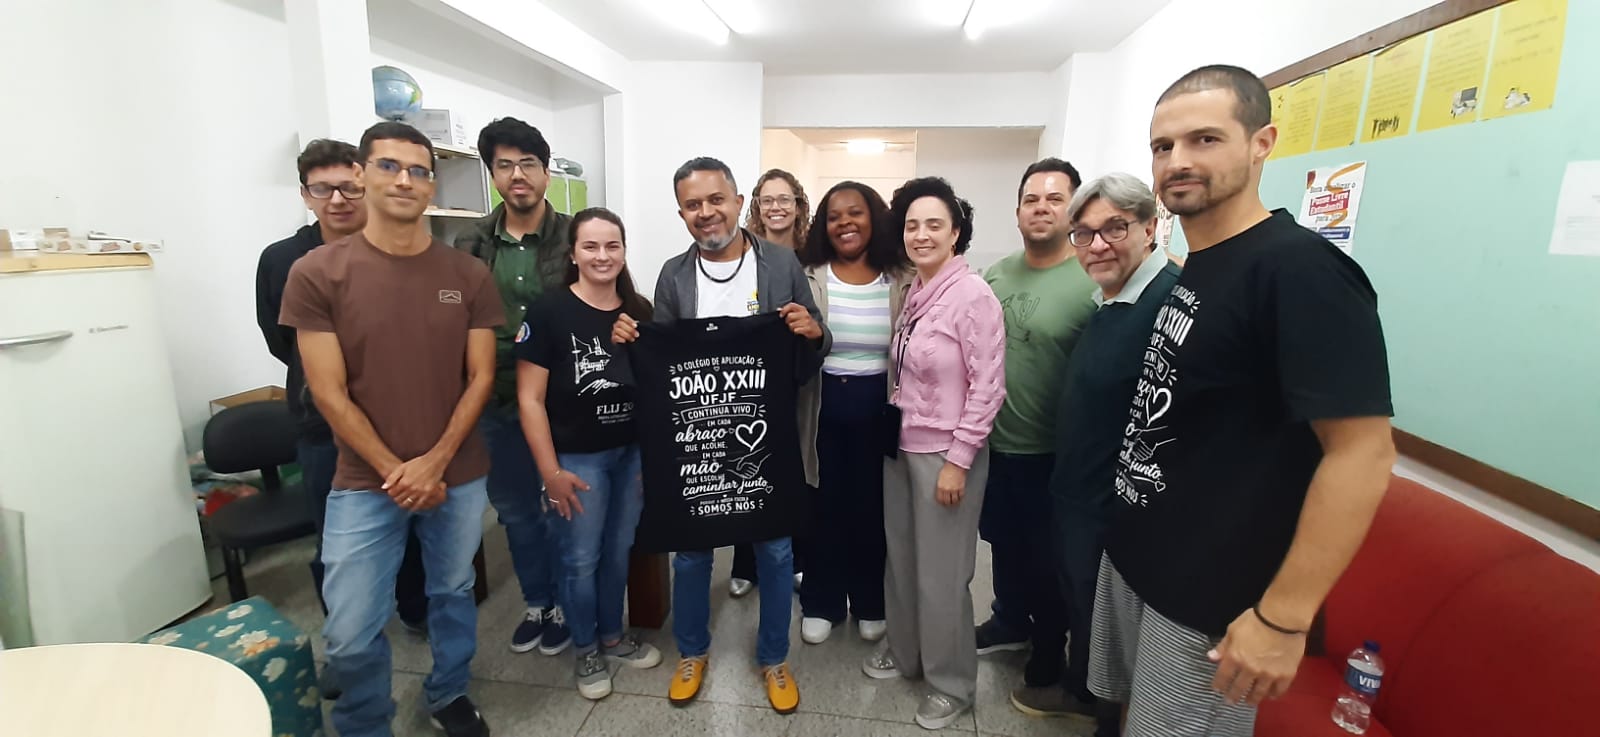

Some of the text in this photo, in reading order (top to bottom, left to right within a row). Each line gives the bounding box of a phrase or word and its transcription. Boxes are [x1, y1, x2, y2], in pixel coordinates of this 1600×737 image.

[677, 355, 755, 372] O COLÉGIO DE APLICAÇÃO
[669, 369, 766, 400] JOÃO XXIII
[700, 391, 737, 406] UFJF
[596, 403, 620, 415] FLIJ
[687, 405, 751, 420] CONTINUA VIVO
[675, 424, 728, 442] abraço
[684, 444, 698, 453] QUE
[702, 452, 711, 460] EM
[680, 459, 723, 477] mão
[682, 476, 768, 496] caminhar junto
[697, 502, 732, 515] SOMOS
